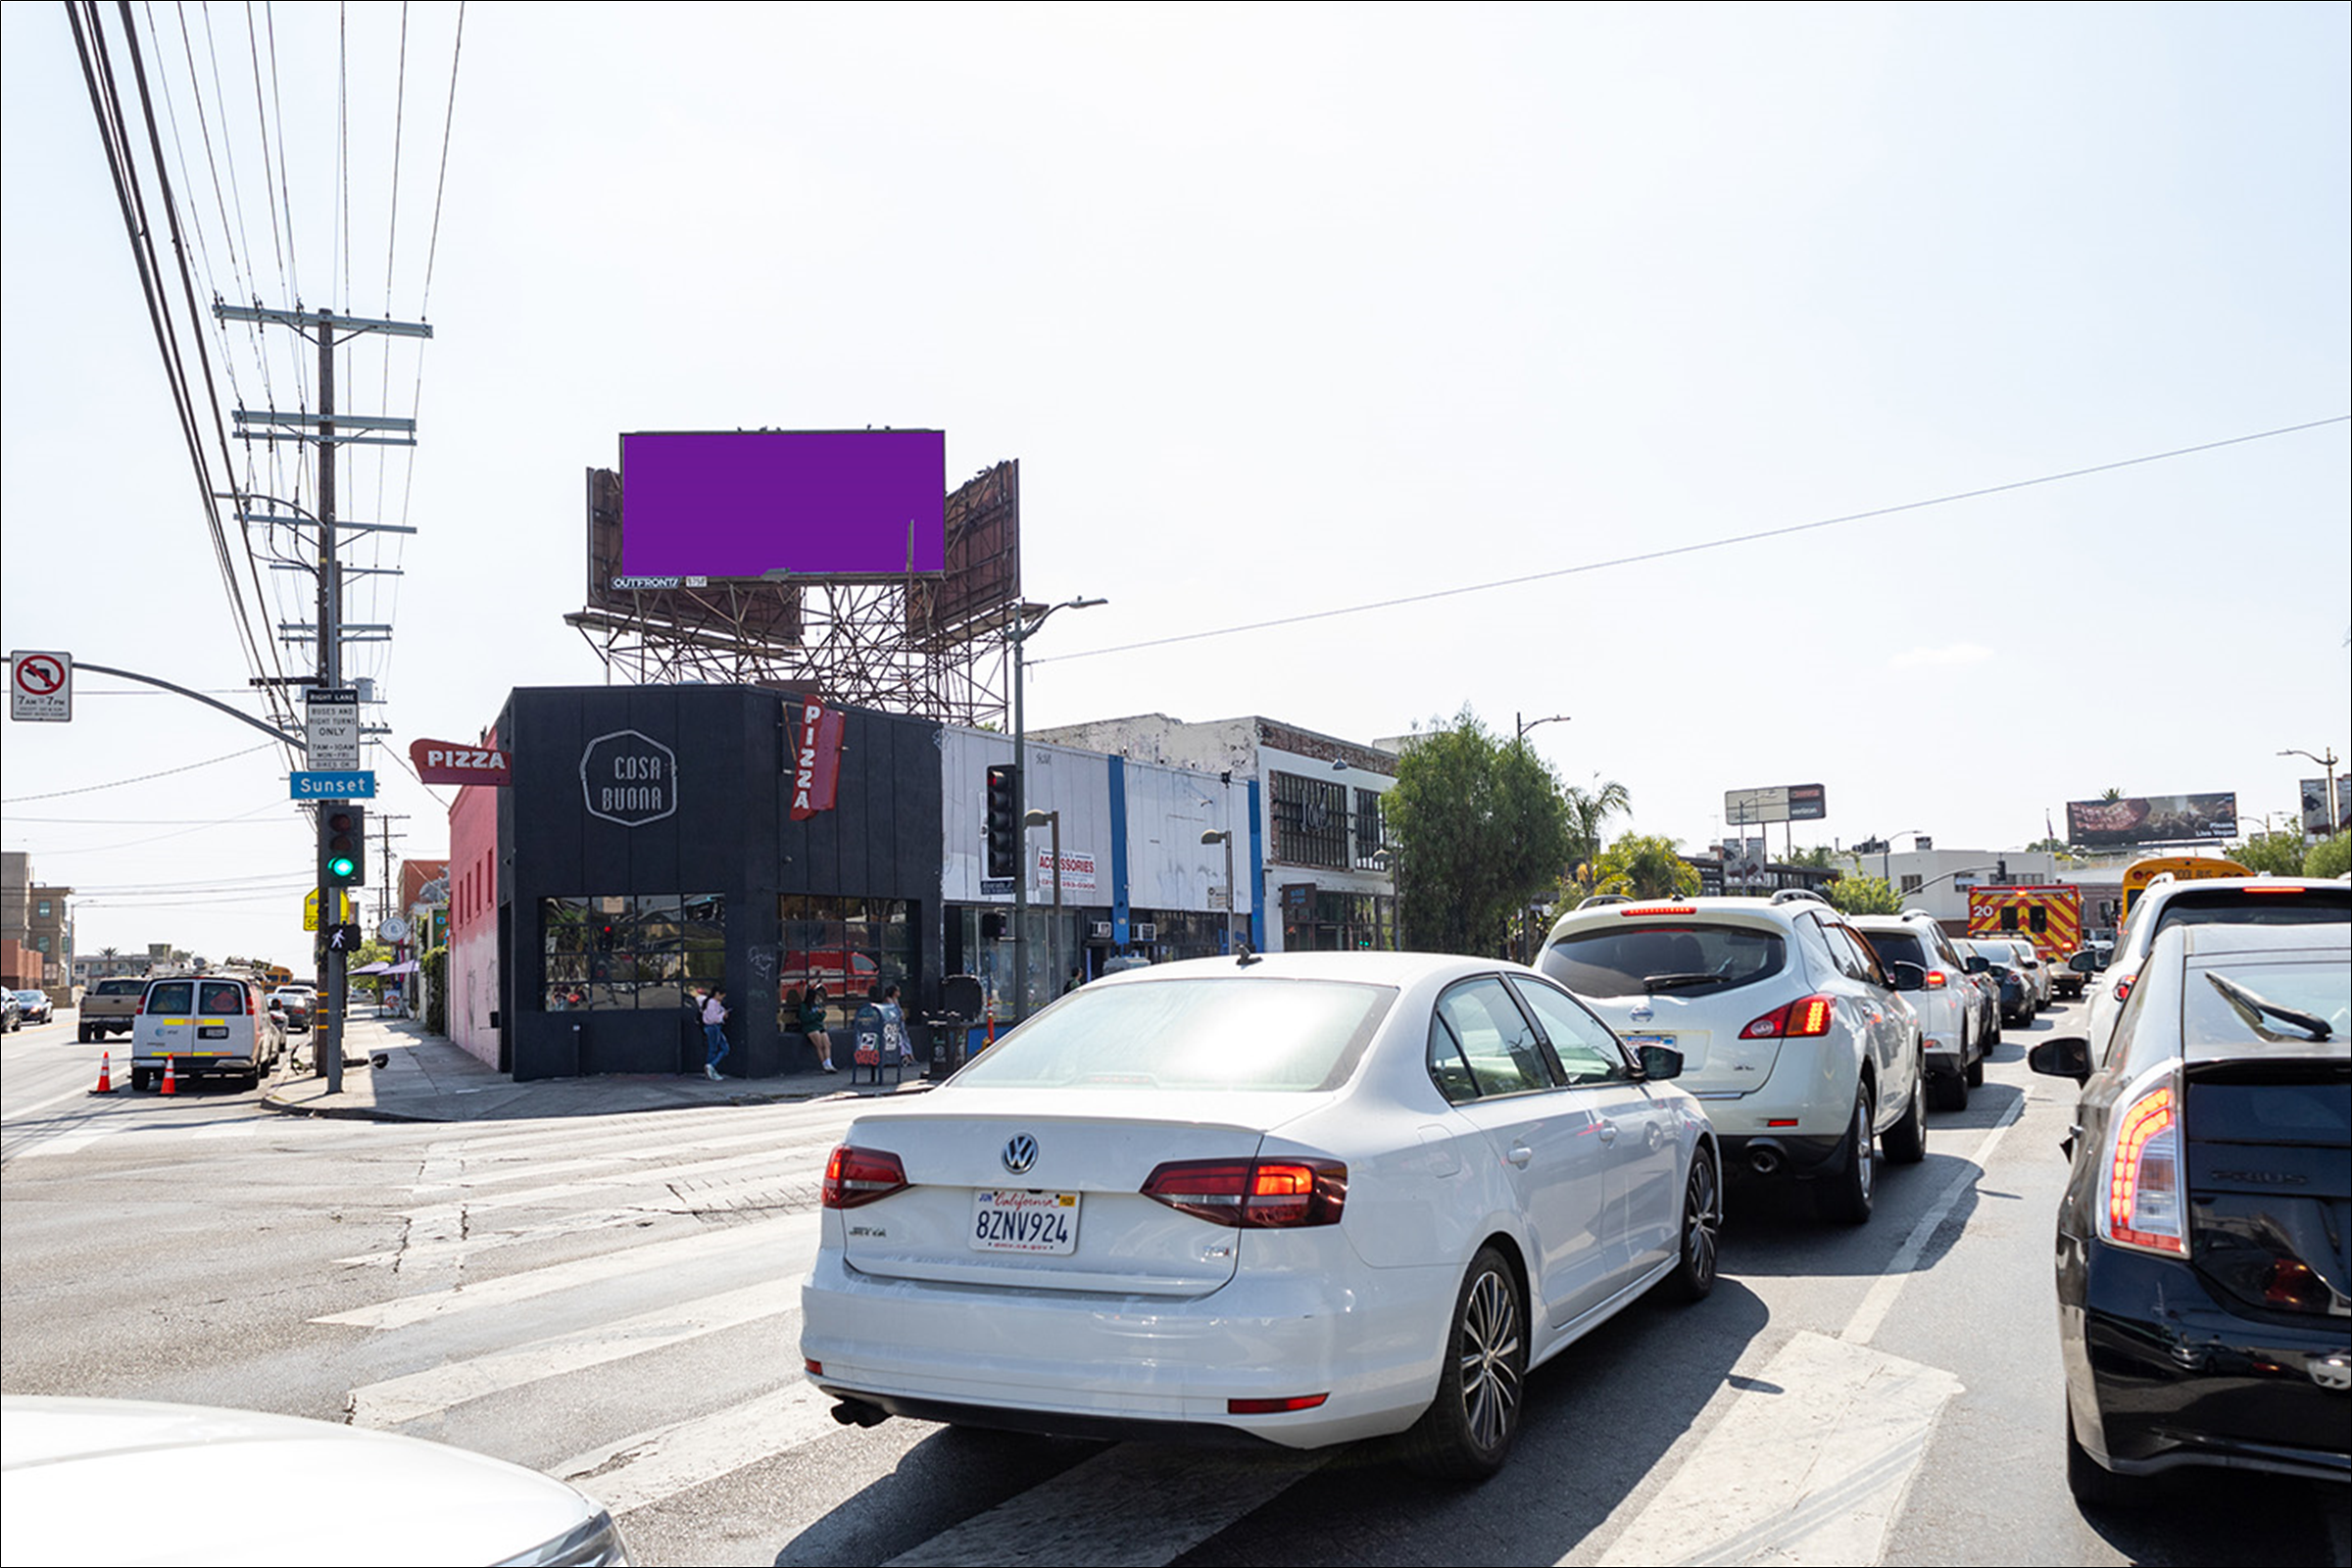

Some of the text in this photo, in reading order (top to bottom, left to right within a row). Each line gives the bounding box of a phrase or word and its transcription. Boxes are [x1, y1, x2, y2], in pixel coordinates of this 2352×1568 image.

[18, 695, 36, 705] 7AM
[46, 696, 65, 706] 7PM
[318, 727, 346, 737] ONLY
[427, 750, 506, 768] PIZZA
[793, 706, 821, 808] PIZZA
[614, 756, 661, 780] COSA
[300, 778, 366, 792] Sunset
[602, 786, 662, 811] BUONA
[1039, 856, 1095, 873] ACCSSORIES
[1973, 906, 1993, 917] 20
[995, 1191, 1058, 1211] California
[976, 1209, 1068, 1244] 8ZNV924
